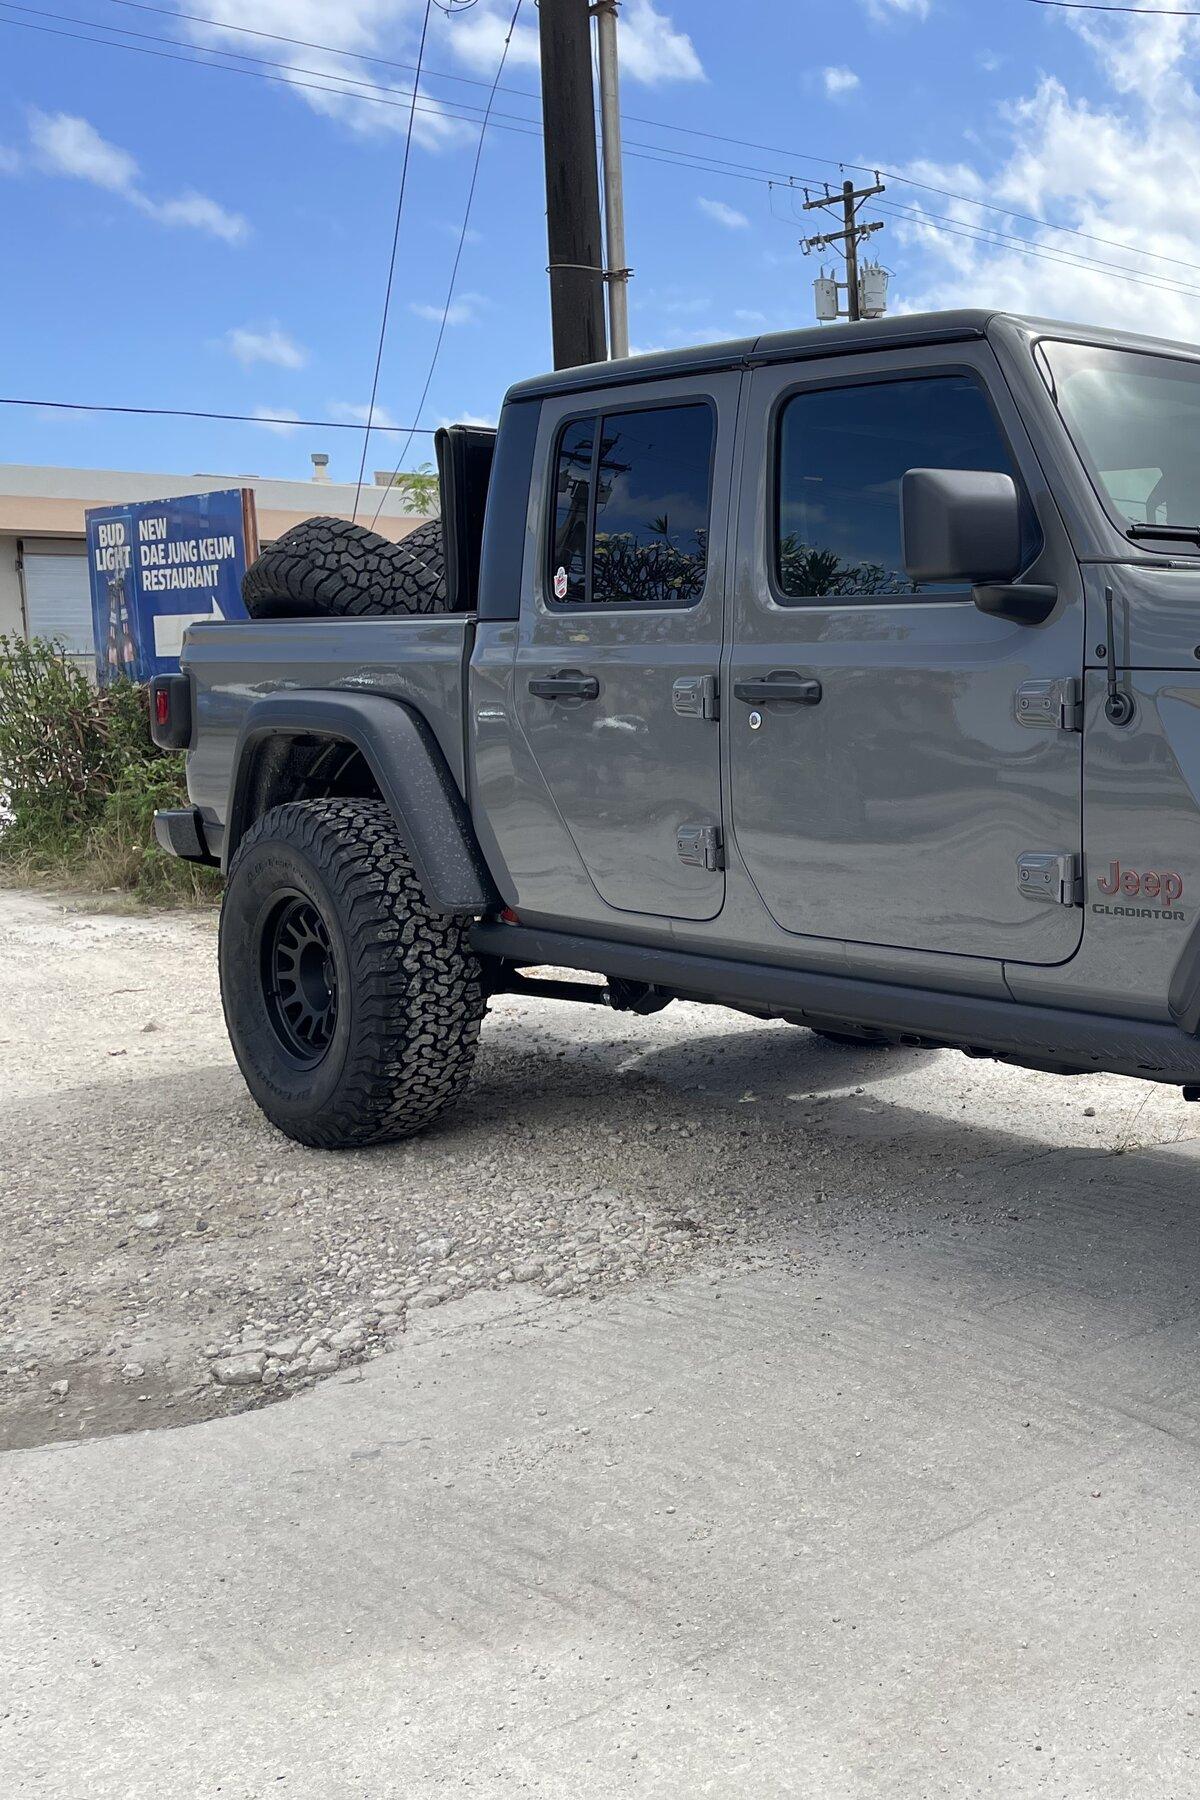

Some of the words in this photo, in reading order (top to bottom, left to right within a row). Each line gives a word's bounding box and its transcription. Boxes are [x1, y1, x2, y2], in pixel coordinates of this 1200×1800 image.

[98, 523, 125, 547] BUD
[138, 518, 167, 541] NEW
[95, 546, 131, 571] LIGHT
[140, 544, 167, 566] DAE
[167, 540, 198, 564] JUNG
[199, 536, 236, 561] KEUM
[142, 565, 219, 591] RESTAURANT
[1096, 860, 1184, 907] Jeep
[1092, 903, 1185, 921] GLADIATOR
